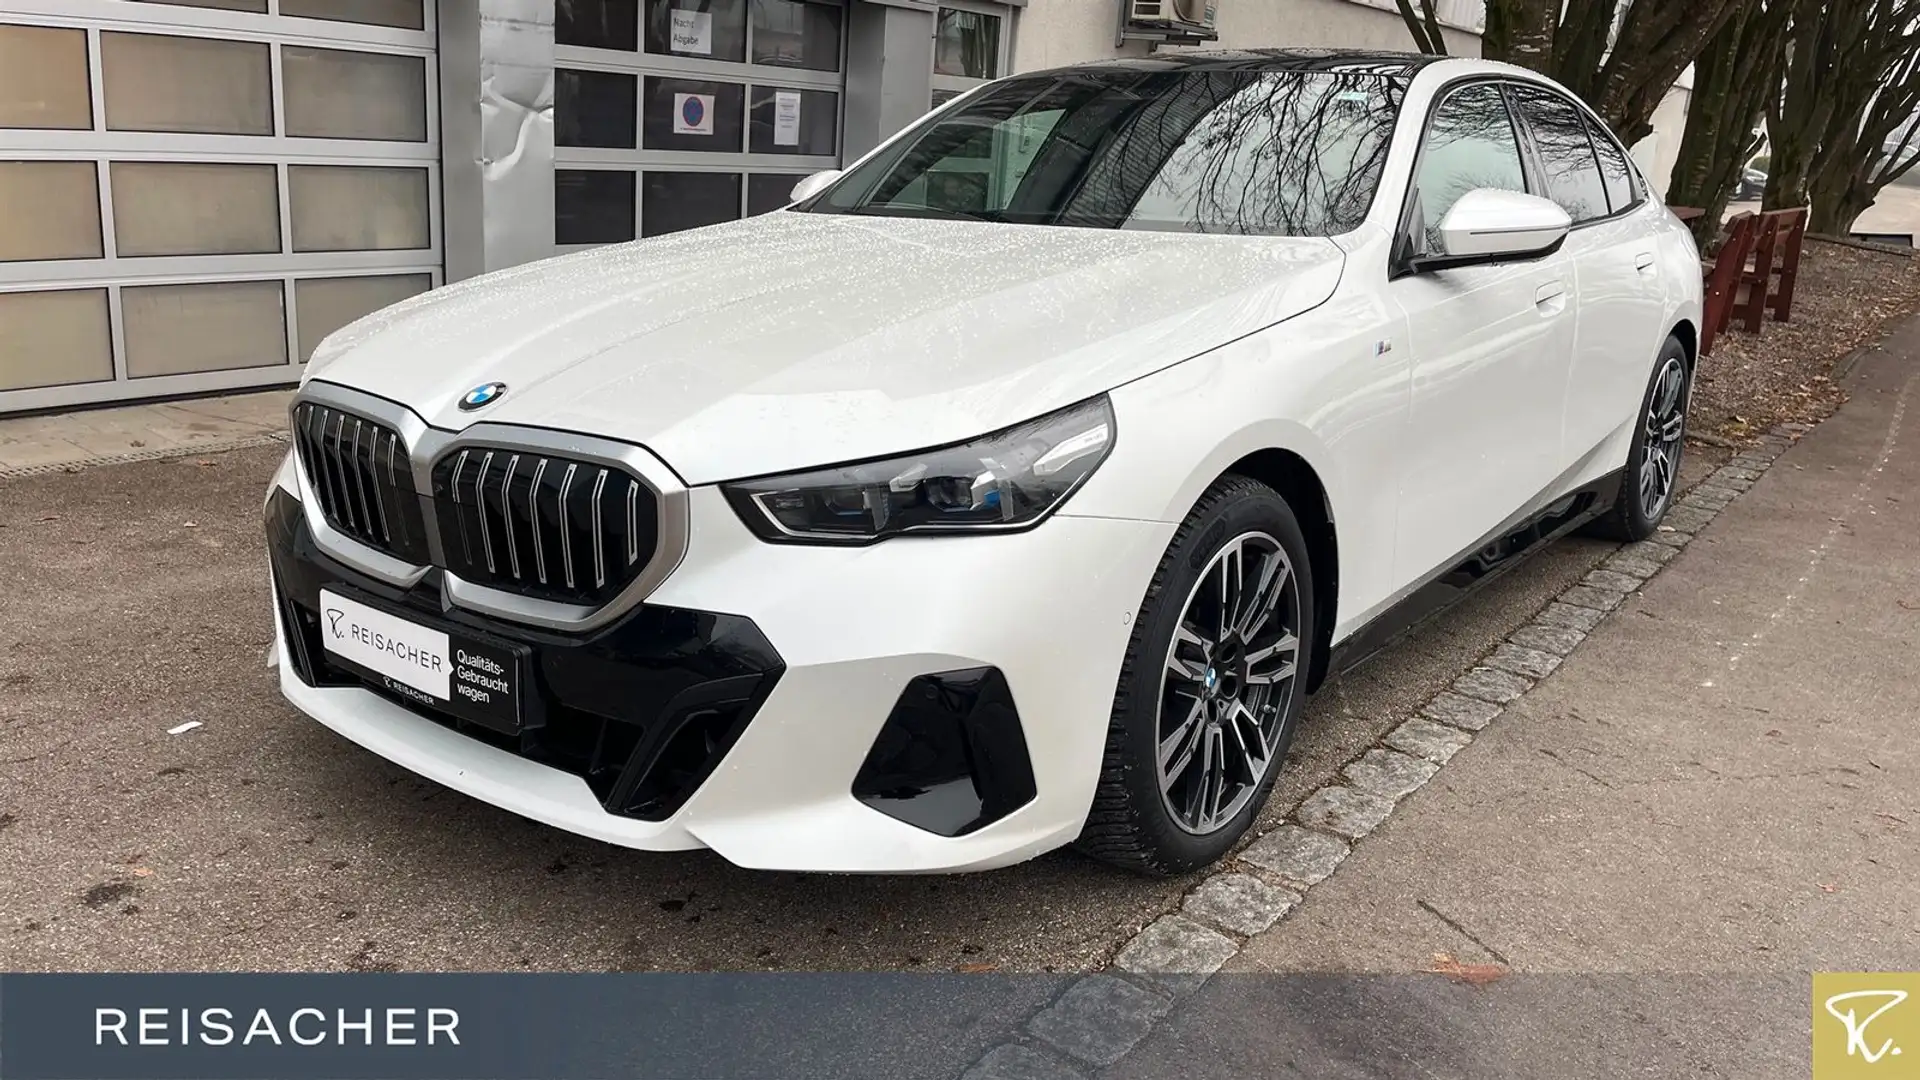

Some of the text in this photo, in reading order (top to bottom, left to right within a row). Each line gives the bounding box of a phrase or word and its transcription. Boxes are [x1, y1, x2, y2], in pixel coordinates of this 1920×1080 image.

[673, 33, 699, 46] Abgabe
[350, 623, 442, 673] REISACHER
[457, 649, 504, 675] Qualitäts-
[457, 665, 509, 694] Gebraucht
[393, 681, 435, 706] REISACHER
[457, 683, 490, 703] wagen
